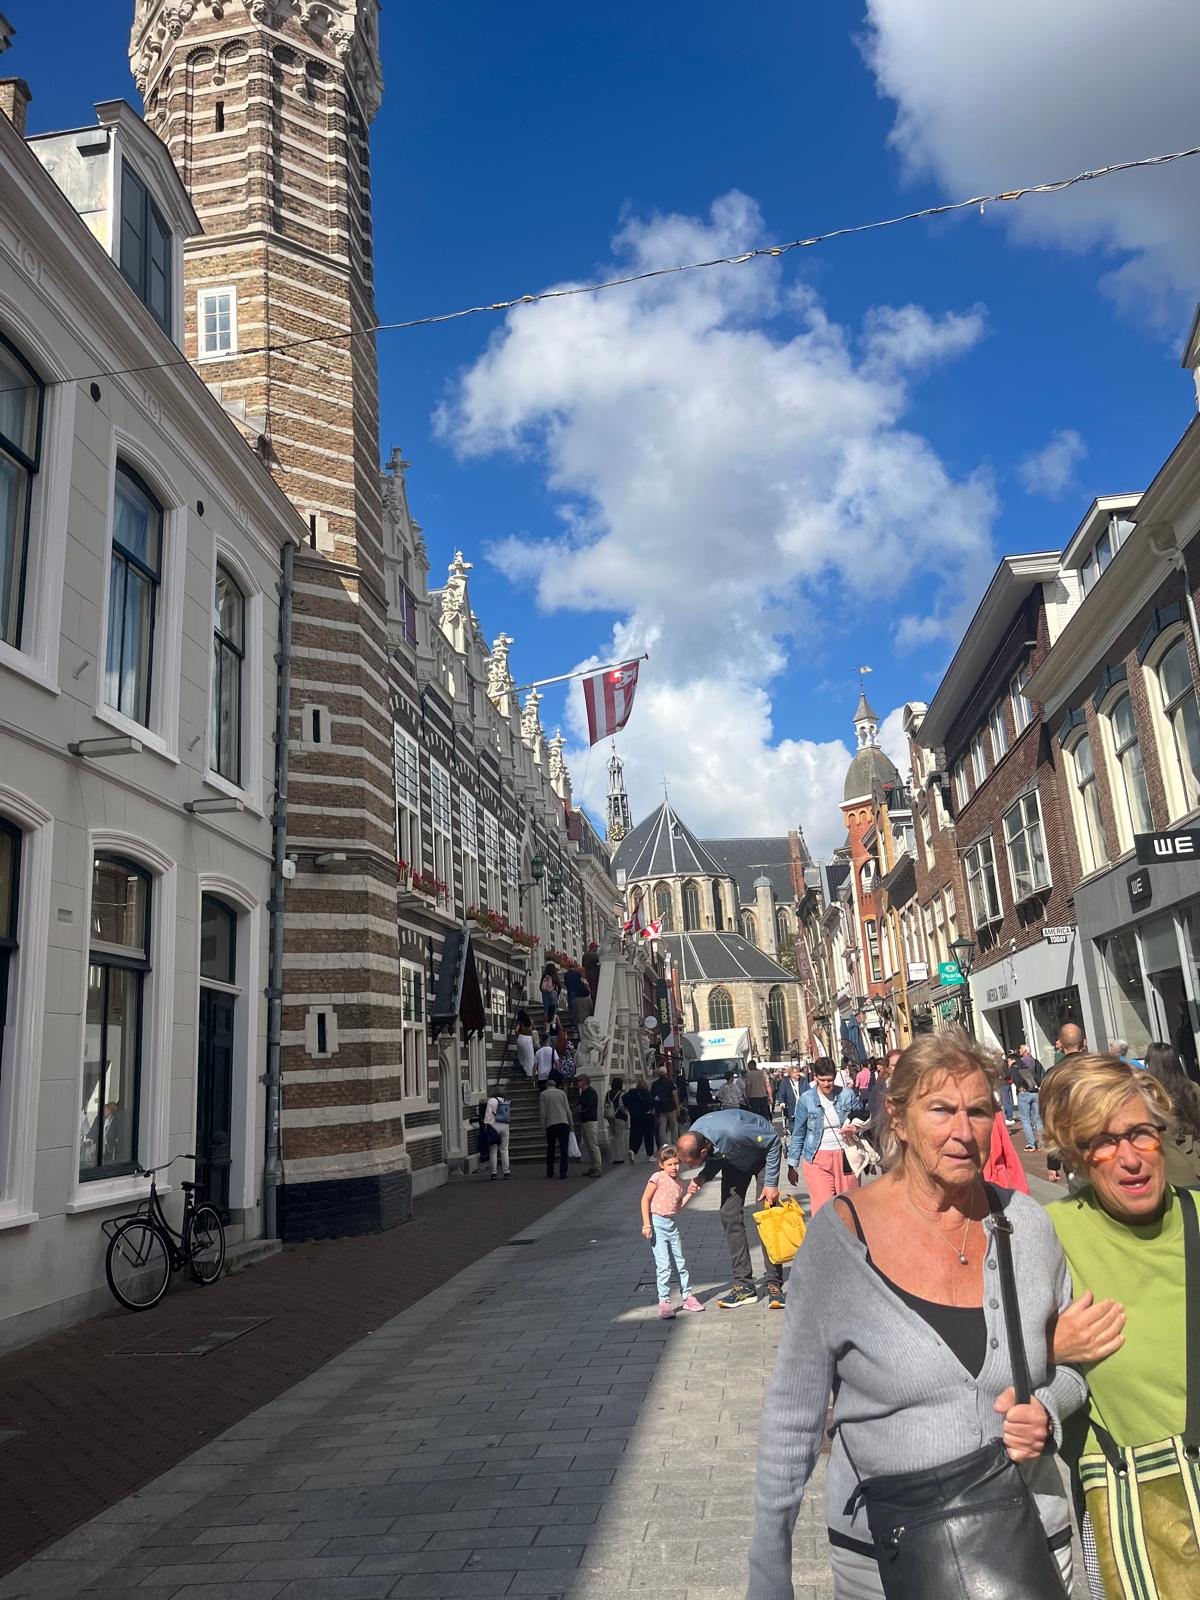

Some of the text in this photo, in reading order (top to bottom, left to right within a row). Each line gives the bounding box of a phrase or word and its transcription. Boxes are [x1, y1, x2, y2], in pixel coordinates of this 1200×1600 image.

[1153, 836, 1194, 856] WE
[1130, 877, 1143, 895] WE
[1044, 927, 1070, 935] AMERICA
